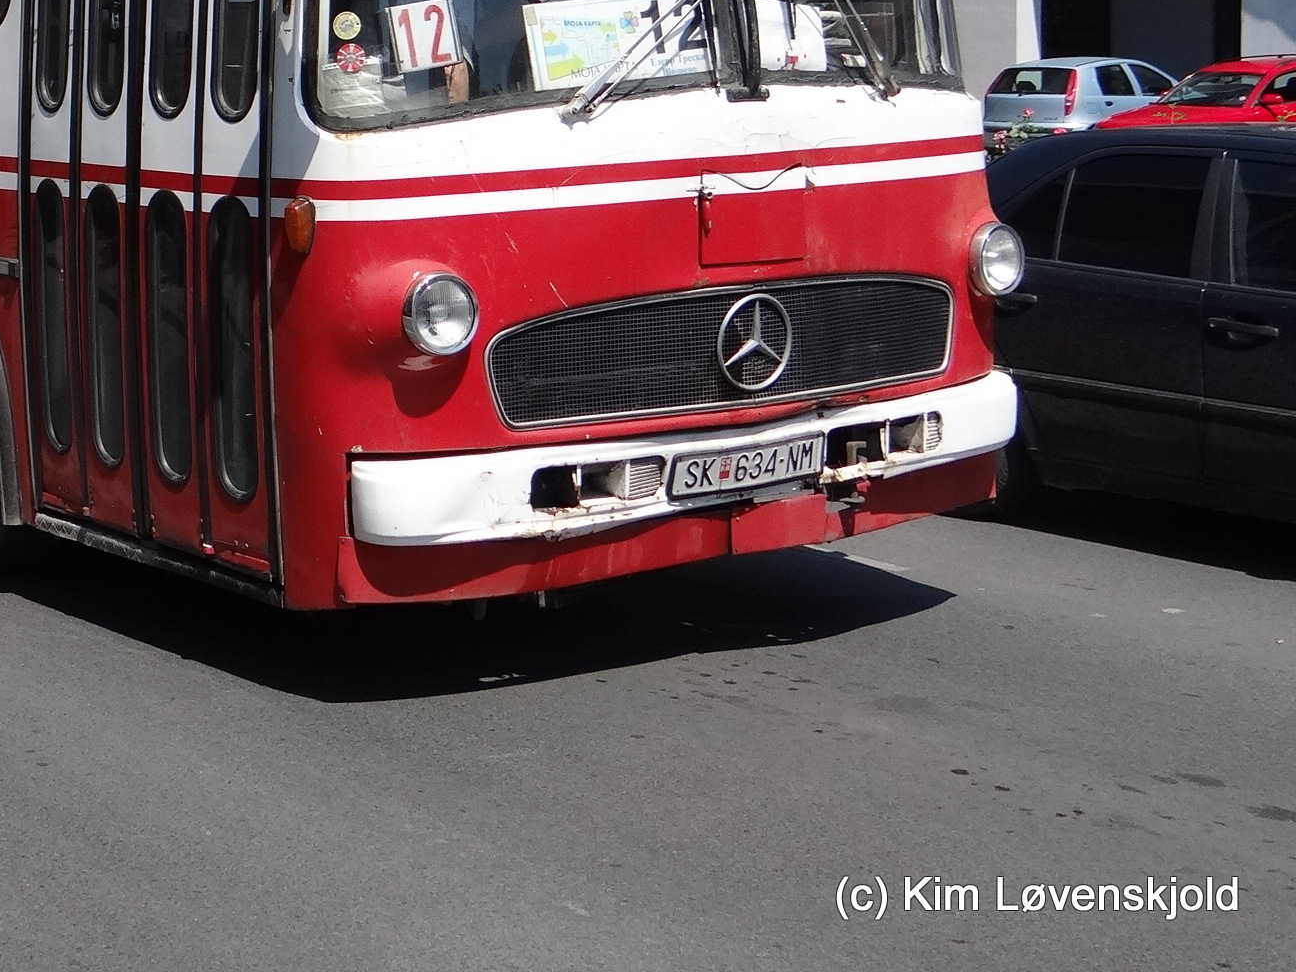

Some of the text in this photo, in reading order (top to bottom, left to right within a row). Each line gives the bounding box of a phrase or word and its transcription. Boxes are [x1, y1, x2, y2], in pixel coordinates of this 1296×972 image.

[397, 4, 452, 68] 12
[570, 65, 601, 80] МОЈА
[684, 458, 716, 489] SK
